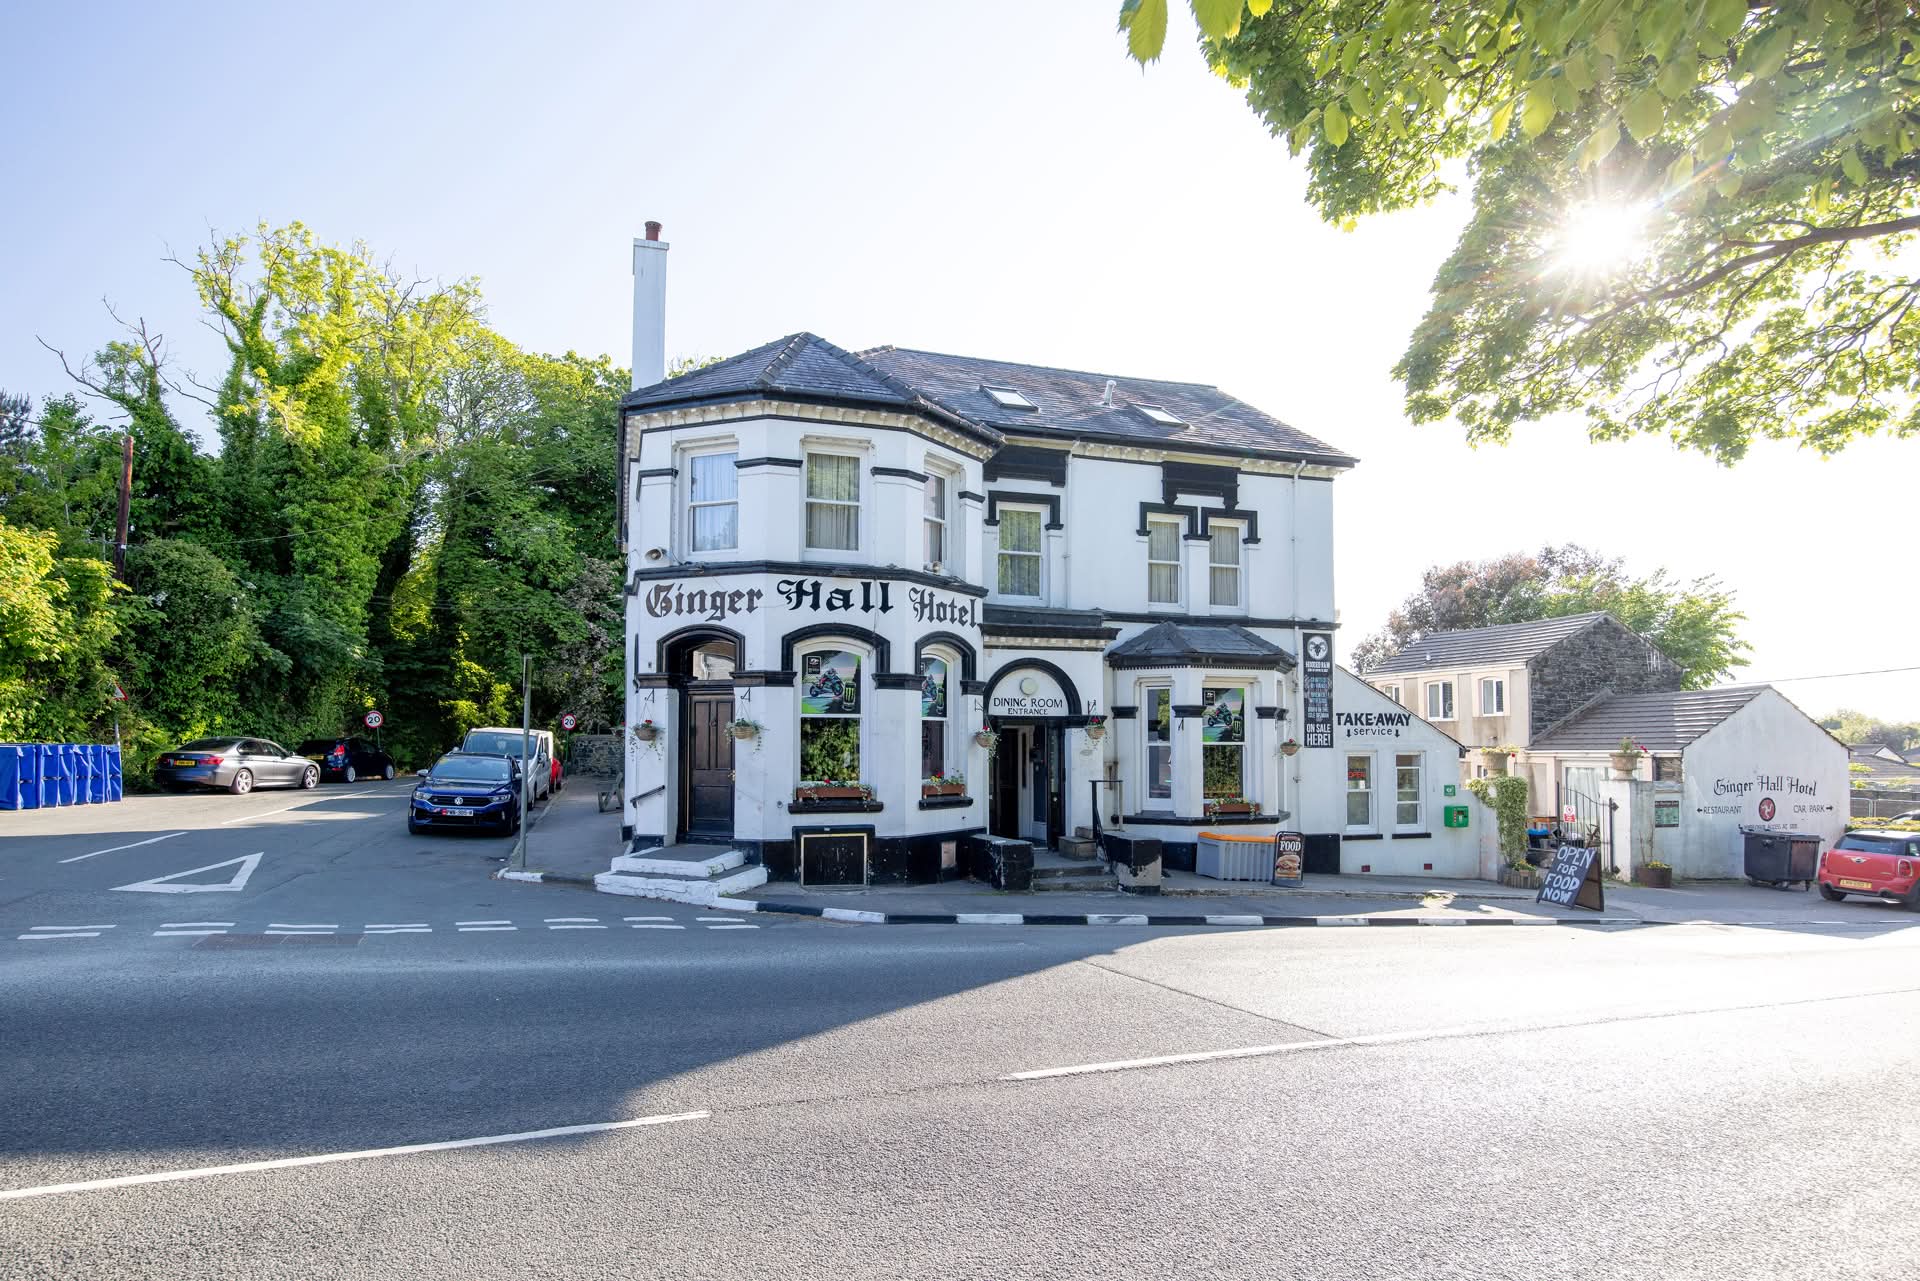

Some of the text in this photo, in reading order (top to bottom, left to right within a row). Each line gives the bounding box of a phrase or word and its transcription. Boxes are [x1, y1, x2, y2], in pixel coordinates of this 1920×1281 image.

[646, 578, 978, 628] Ginger Hall Hotel
[993, 697, 1063, 708] DINING ROOM
[1007, 707, 1048, 715] ENTRANCE
[1306, 724, 1331, 733] ON SALE
[1353, 727, 1393, 736] service
[1306, 733, 1331, 746] HERE!
[1713, 775, 1817, 797] Ginger Hall Hotel
[1703, 805, 1742, 815] RESTAURANT
[1793, 804, 1825, 814] CAR PARK
[1280, 841, 1301, 852] FOOD
[1557, 846, 1596, 869] OPEN
[1557, 863, 1577, 876] FOR
[1545, 873, 1580, 891] FOOD
[1542, 888, 1573, 903] NOW
